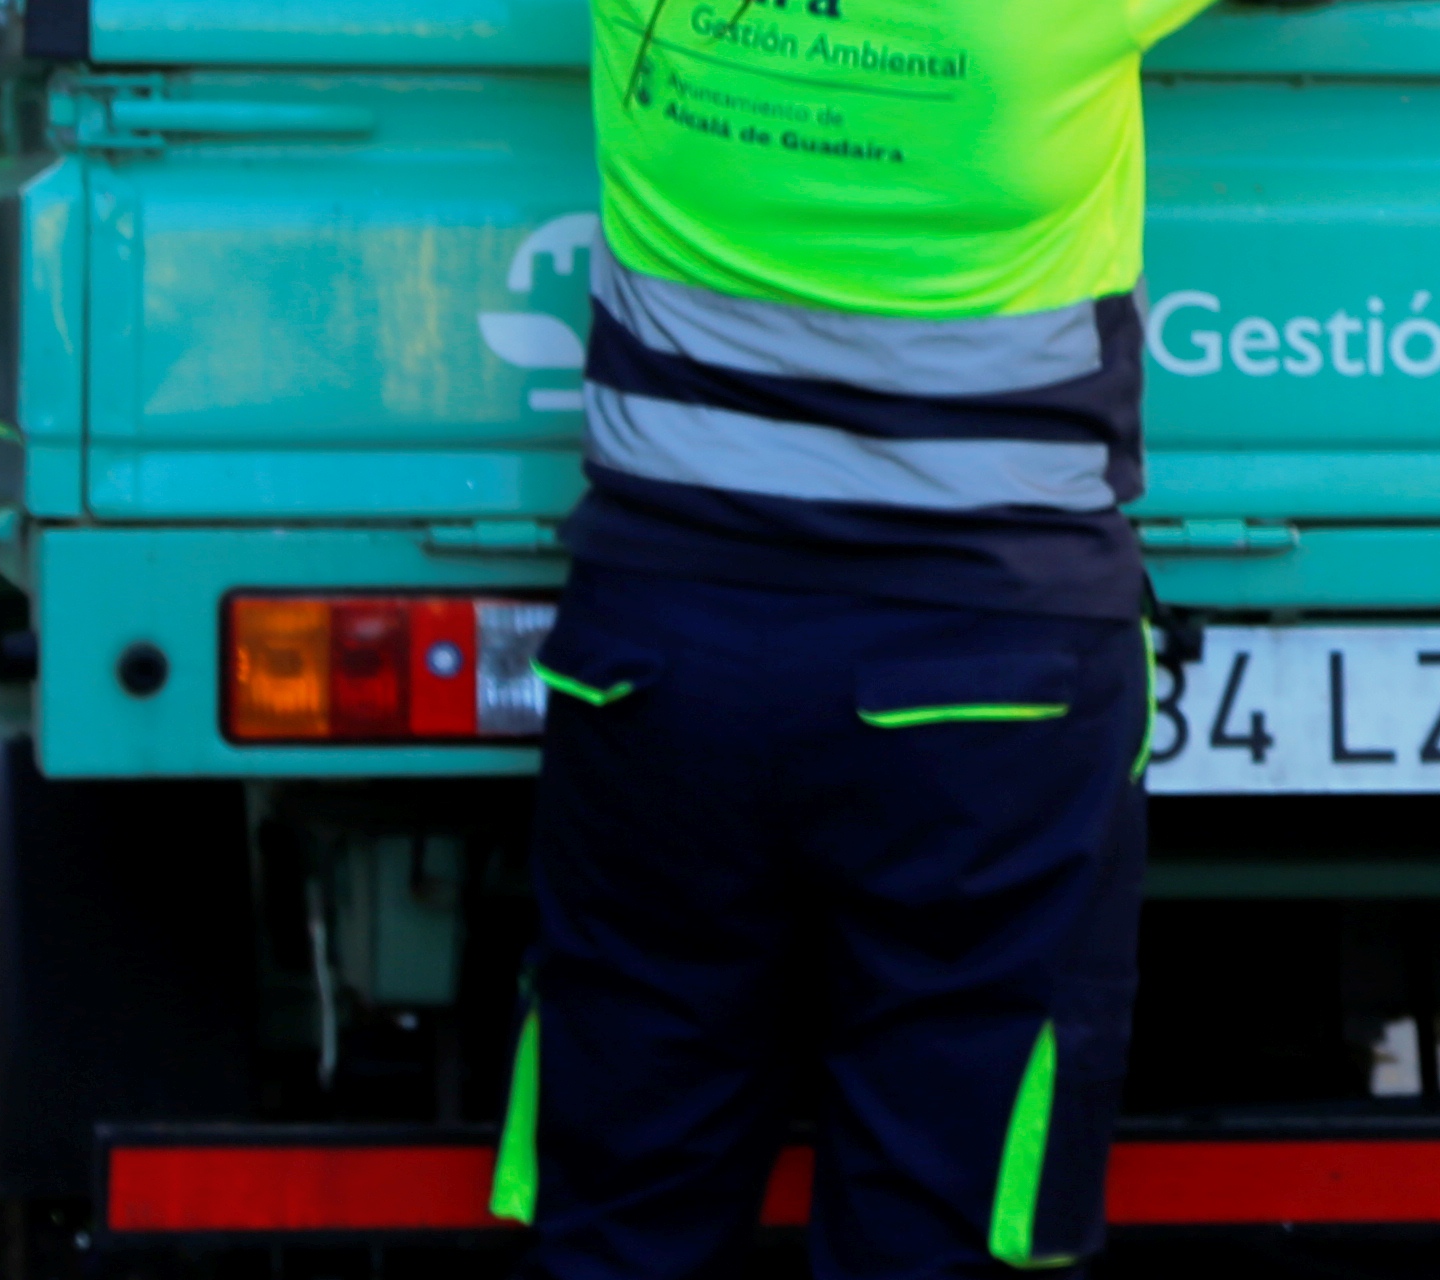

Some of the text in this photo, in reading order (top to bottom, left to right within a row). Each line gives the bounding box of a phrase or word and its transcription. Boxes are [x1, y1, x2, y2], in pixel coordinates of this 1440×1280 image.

[691, 4, 968, 79] Gestión Ambiental
[740, 125, 772, 146] de
